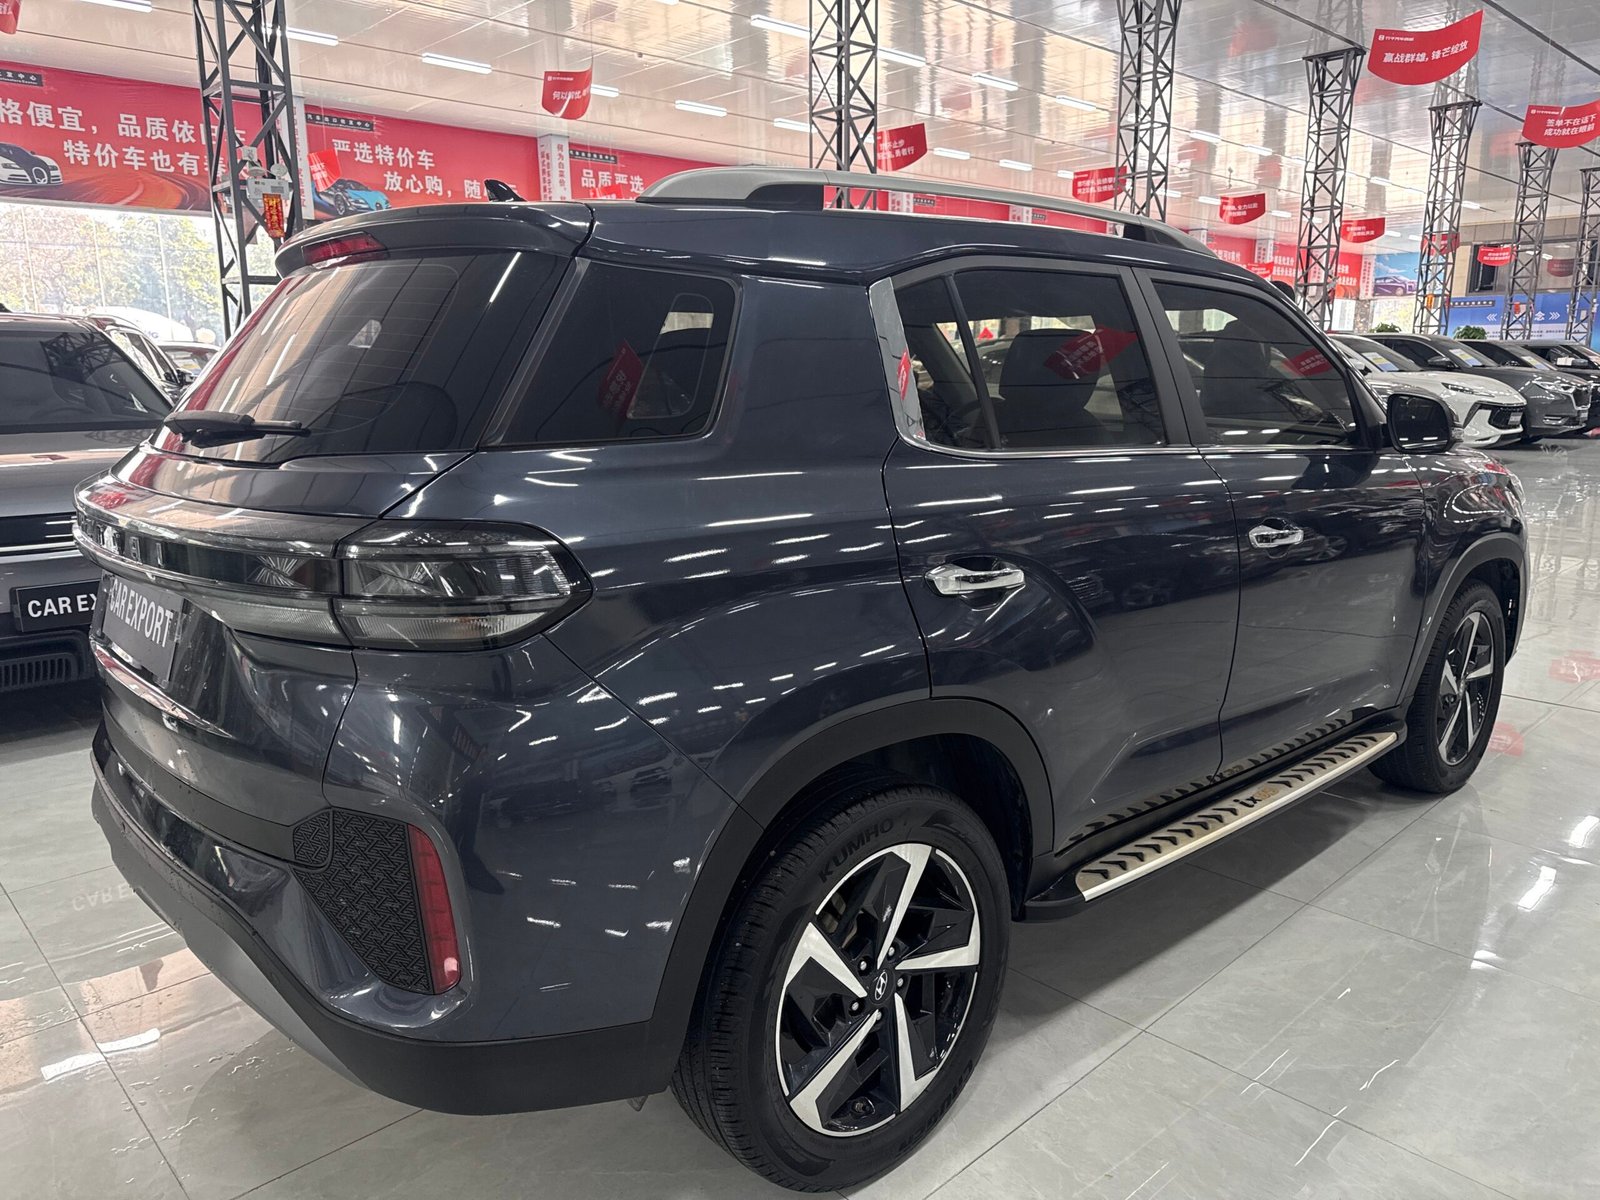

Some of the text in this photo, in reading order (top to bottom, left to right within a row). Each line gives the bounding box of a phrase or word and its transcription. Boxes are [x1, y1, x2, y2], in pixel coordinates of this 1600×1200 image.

[332, 139, 435, 170] 严选特价车
[581, 168, 645, 194] 品质严选
[27, 596, 73, 618] CAR
[110, 578, 174, 647] CAR EXPORT
[819, 819, 895, 883] KUMHO
